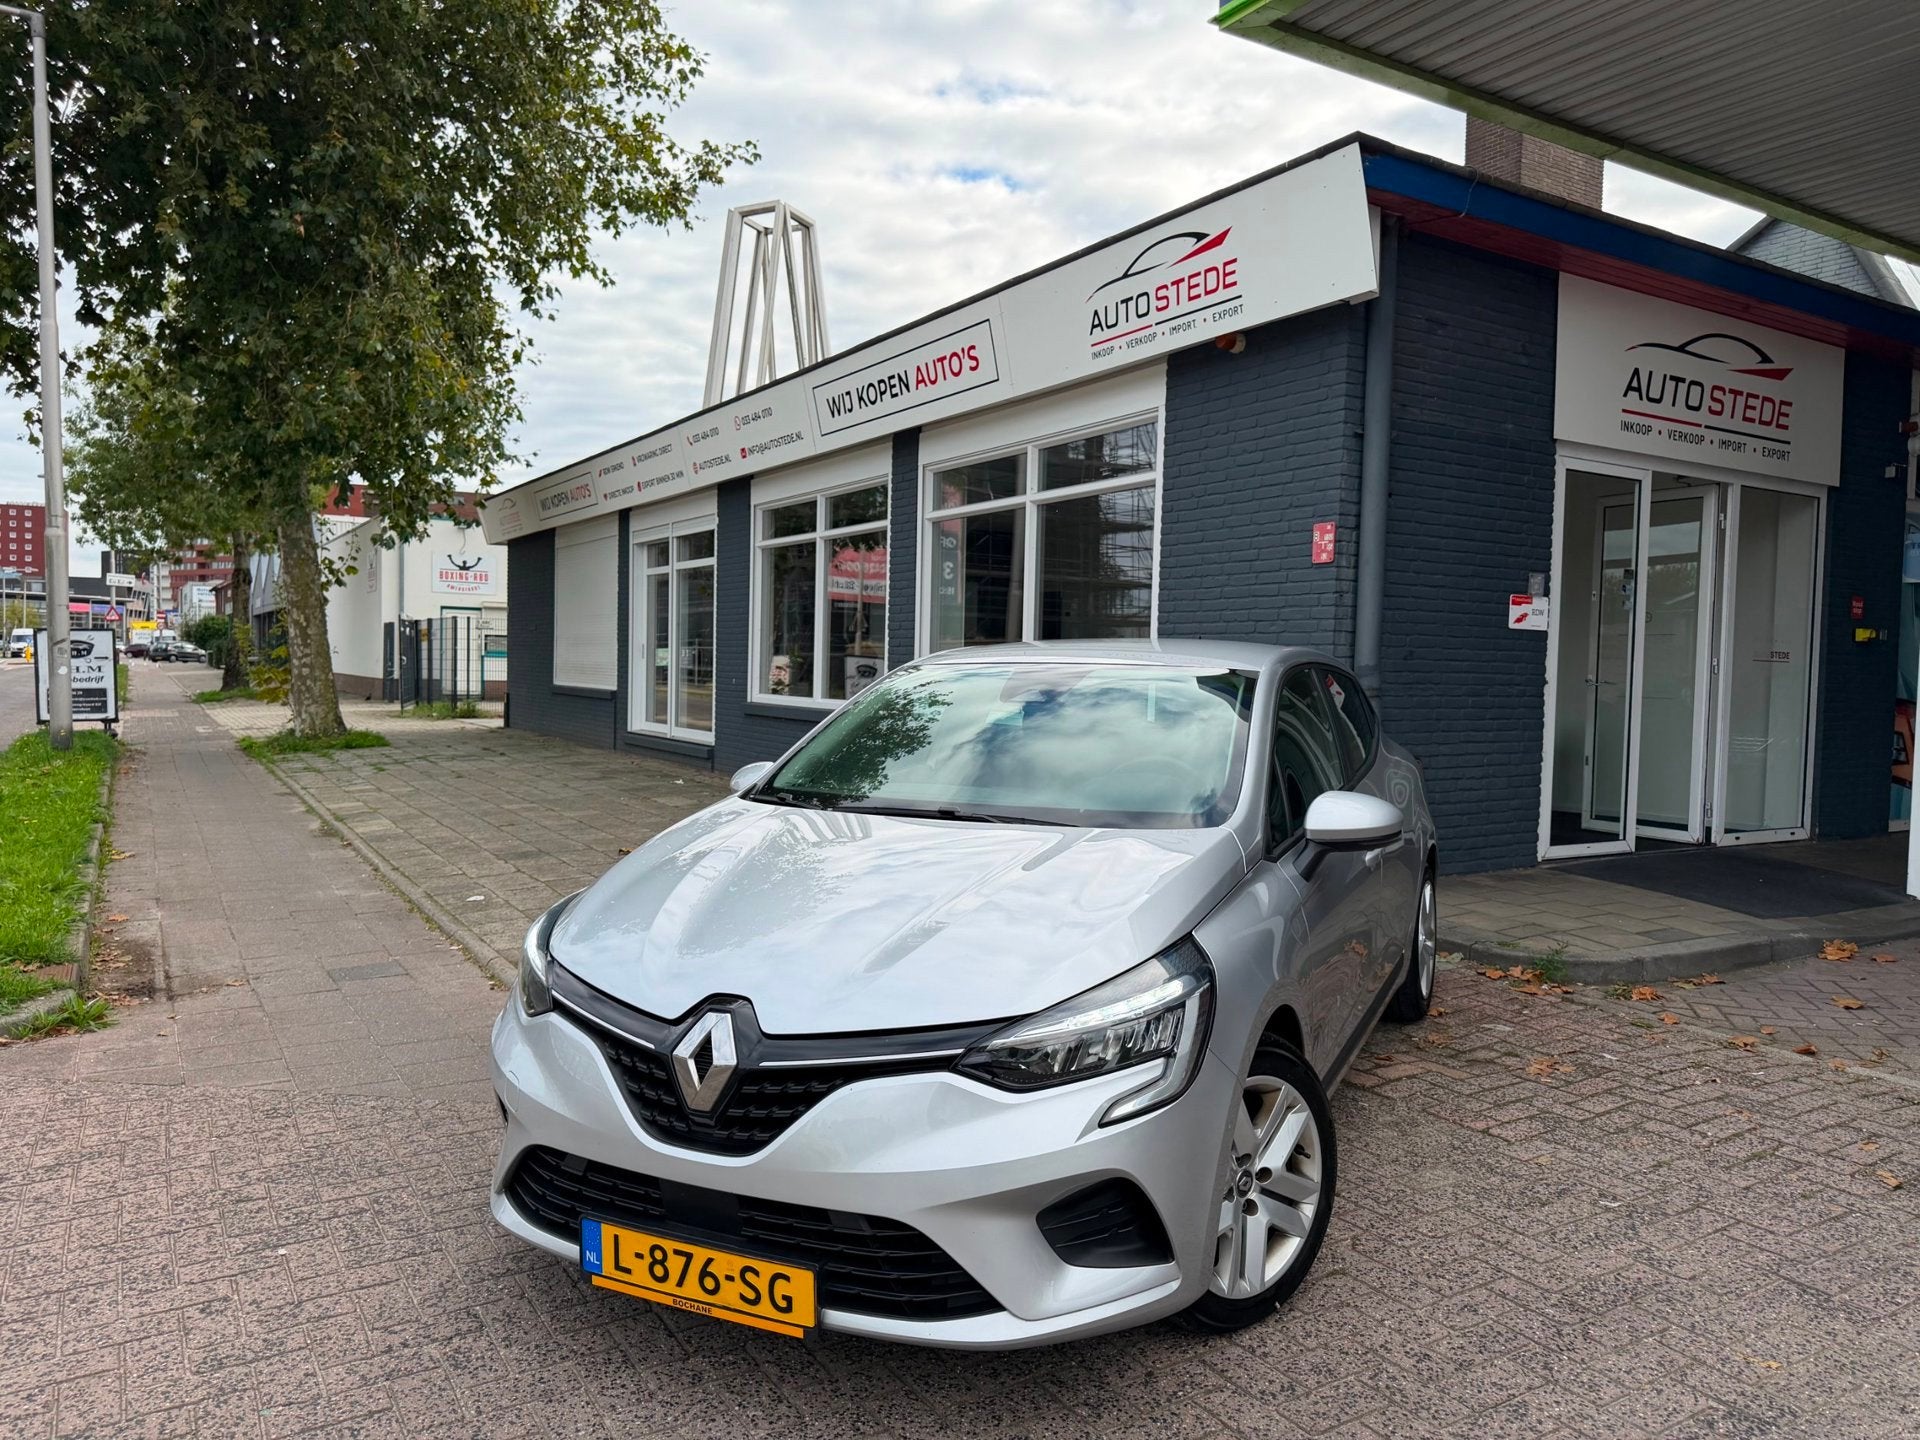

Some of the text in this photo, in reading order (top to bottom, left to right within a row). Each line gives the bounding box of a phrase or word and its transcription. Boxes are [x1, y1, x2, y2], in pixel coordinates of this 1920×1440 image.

[1091, 304, 1244, 361] INKOOP VERKOOP IMPORT EXPORT
[826, 344, 980, 419] WIJ KOPEN AUTO'S
[747, 430, 804, 456] INFO@AUTOSTEDE.NL
[1620, 420, 1792, 462] INKOOP VERKOOP IMPORT EXPORT
[71, 675, 105, 684] bedrijf
[586, 1250, 600, 1265] NL
[613, 1233, 793, 1314] L-876-SG
[672, 1298, 713, 1315] BOCHANE
